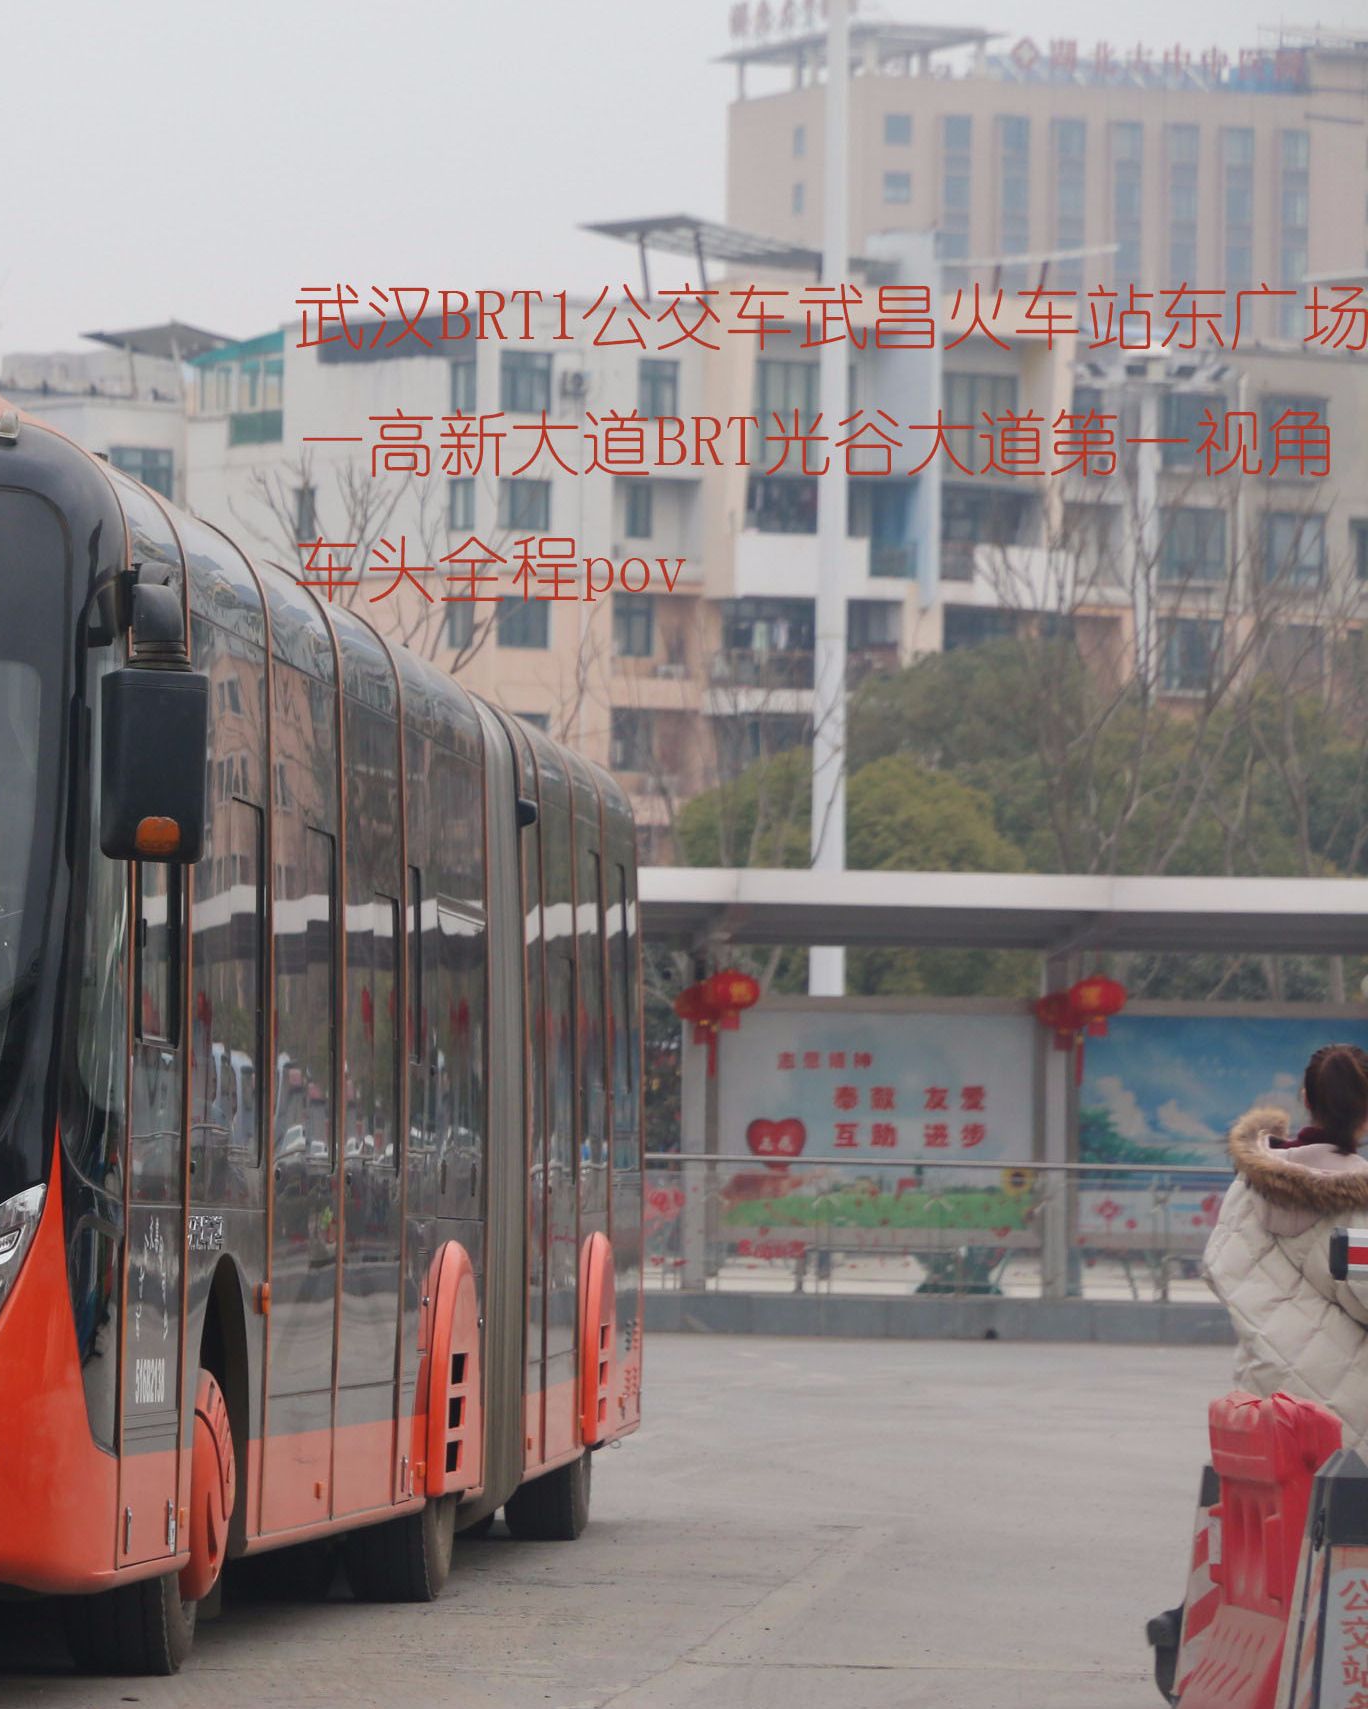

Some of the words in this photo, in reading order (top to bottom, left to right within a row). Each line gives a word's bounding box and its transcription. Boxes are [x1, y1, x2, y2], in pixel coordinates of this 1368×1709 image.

[833, 1086, 896, 1111] 奉献
[924, 1086, 986, 1111] 友爱
[834, 1123, 897, 1147] 互助
[924, 1123, 987, 1148] 进步
